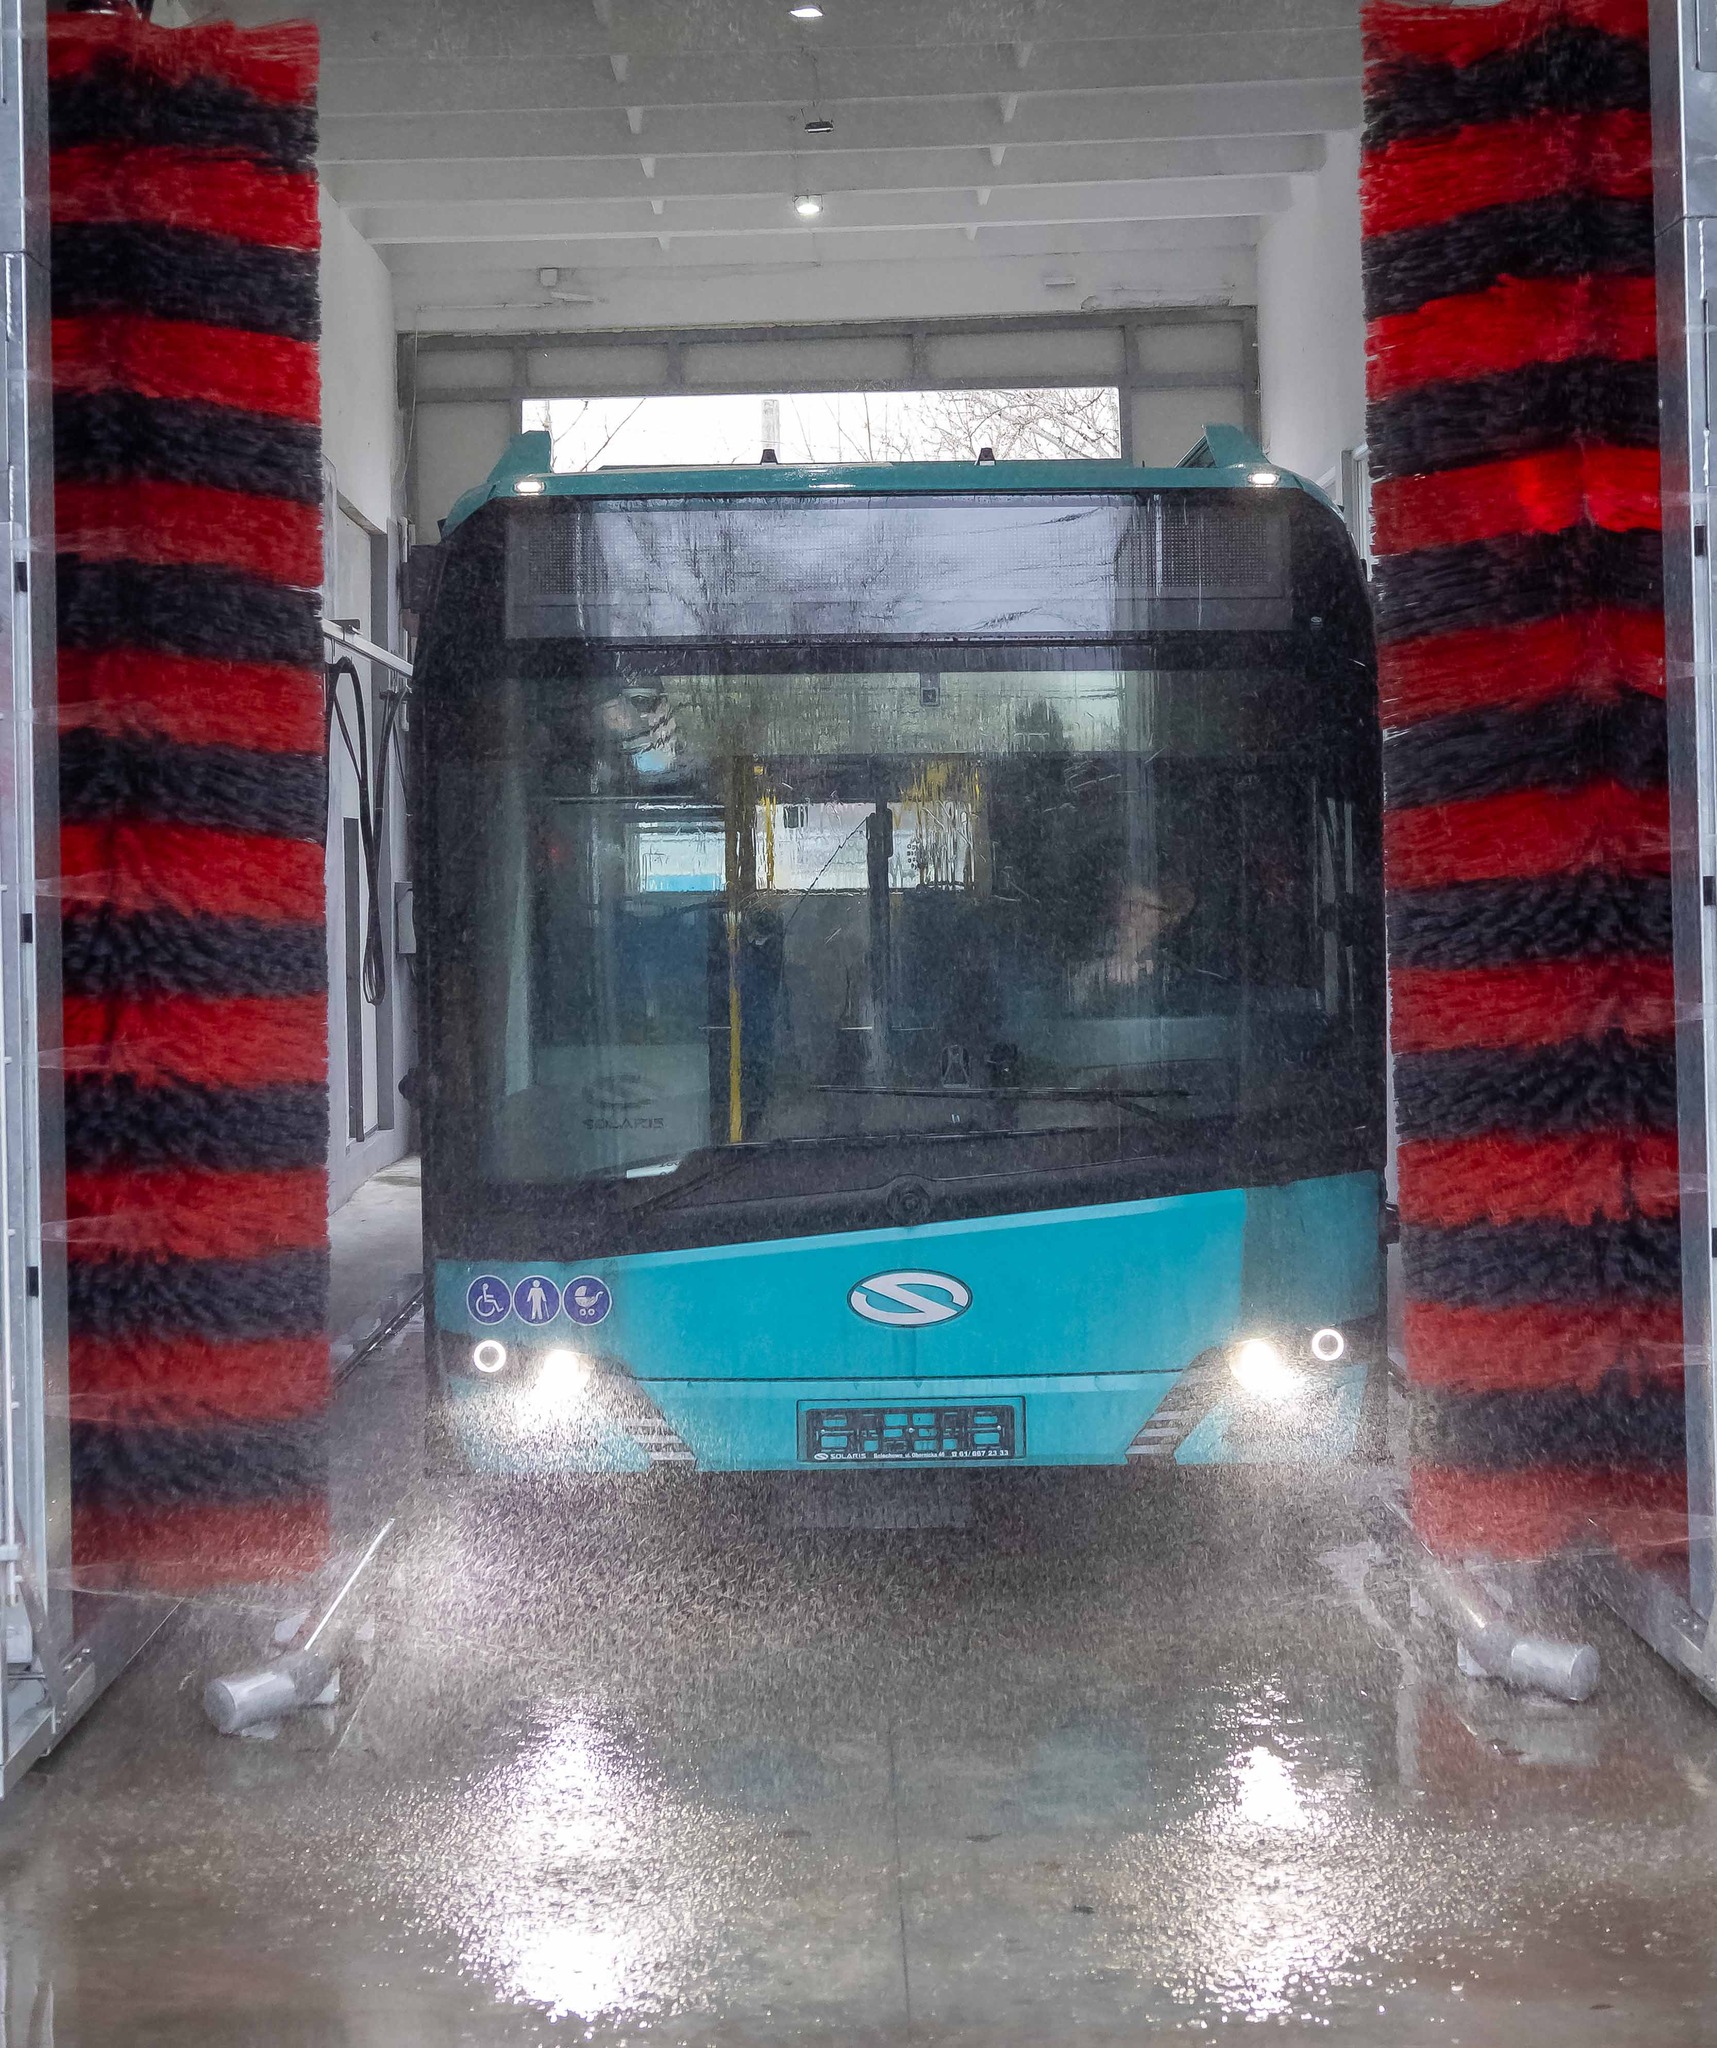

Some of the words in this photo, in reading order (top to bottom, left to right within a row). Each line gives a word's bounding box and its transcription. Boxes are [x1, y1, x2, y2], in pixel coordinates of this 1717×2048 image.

[582, 1117, 664, 1130] SOLARIS
[830, 1452, 867, 1460] SOLARIS
[987, 1449, 997, 1457] 23
